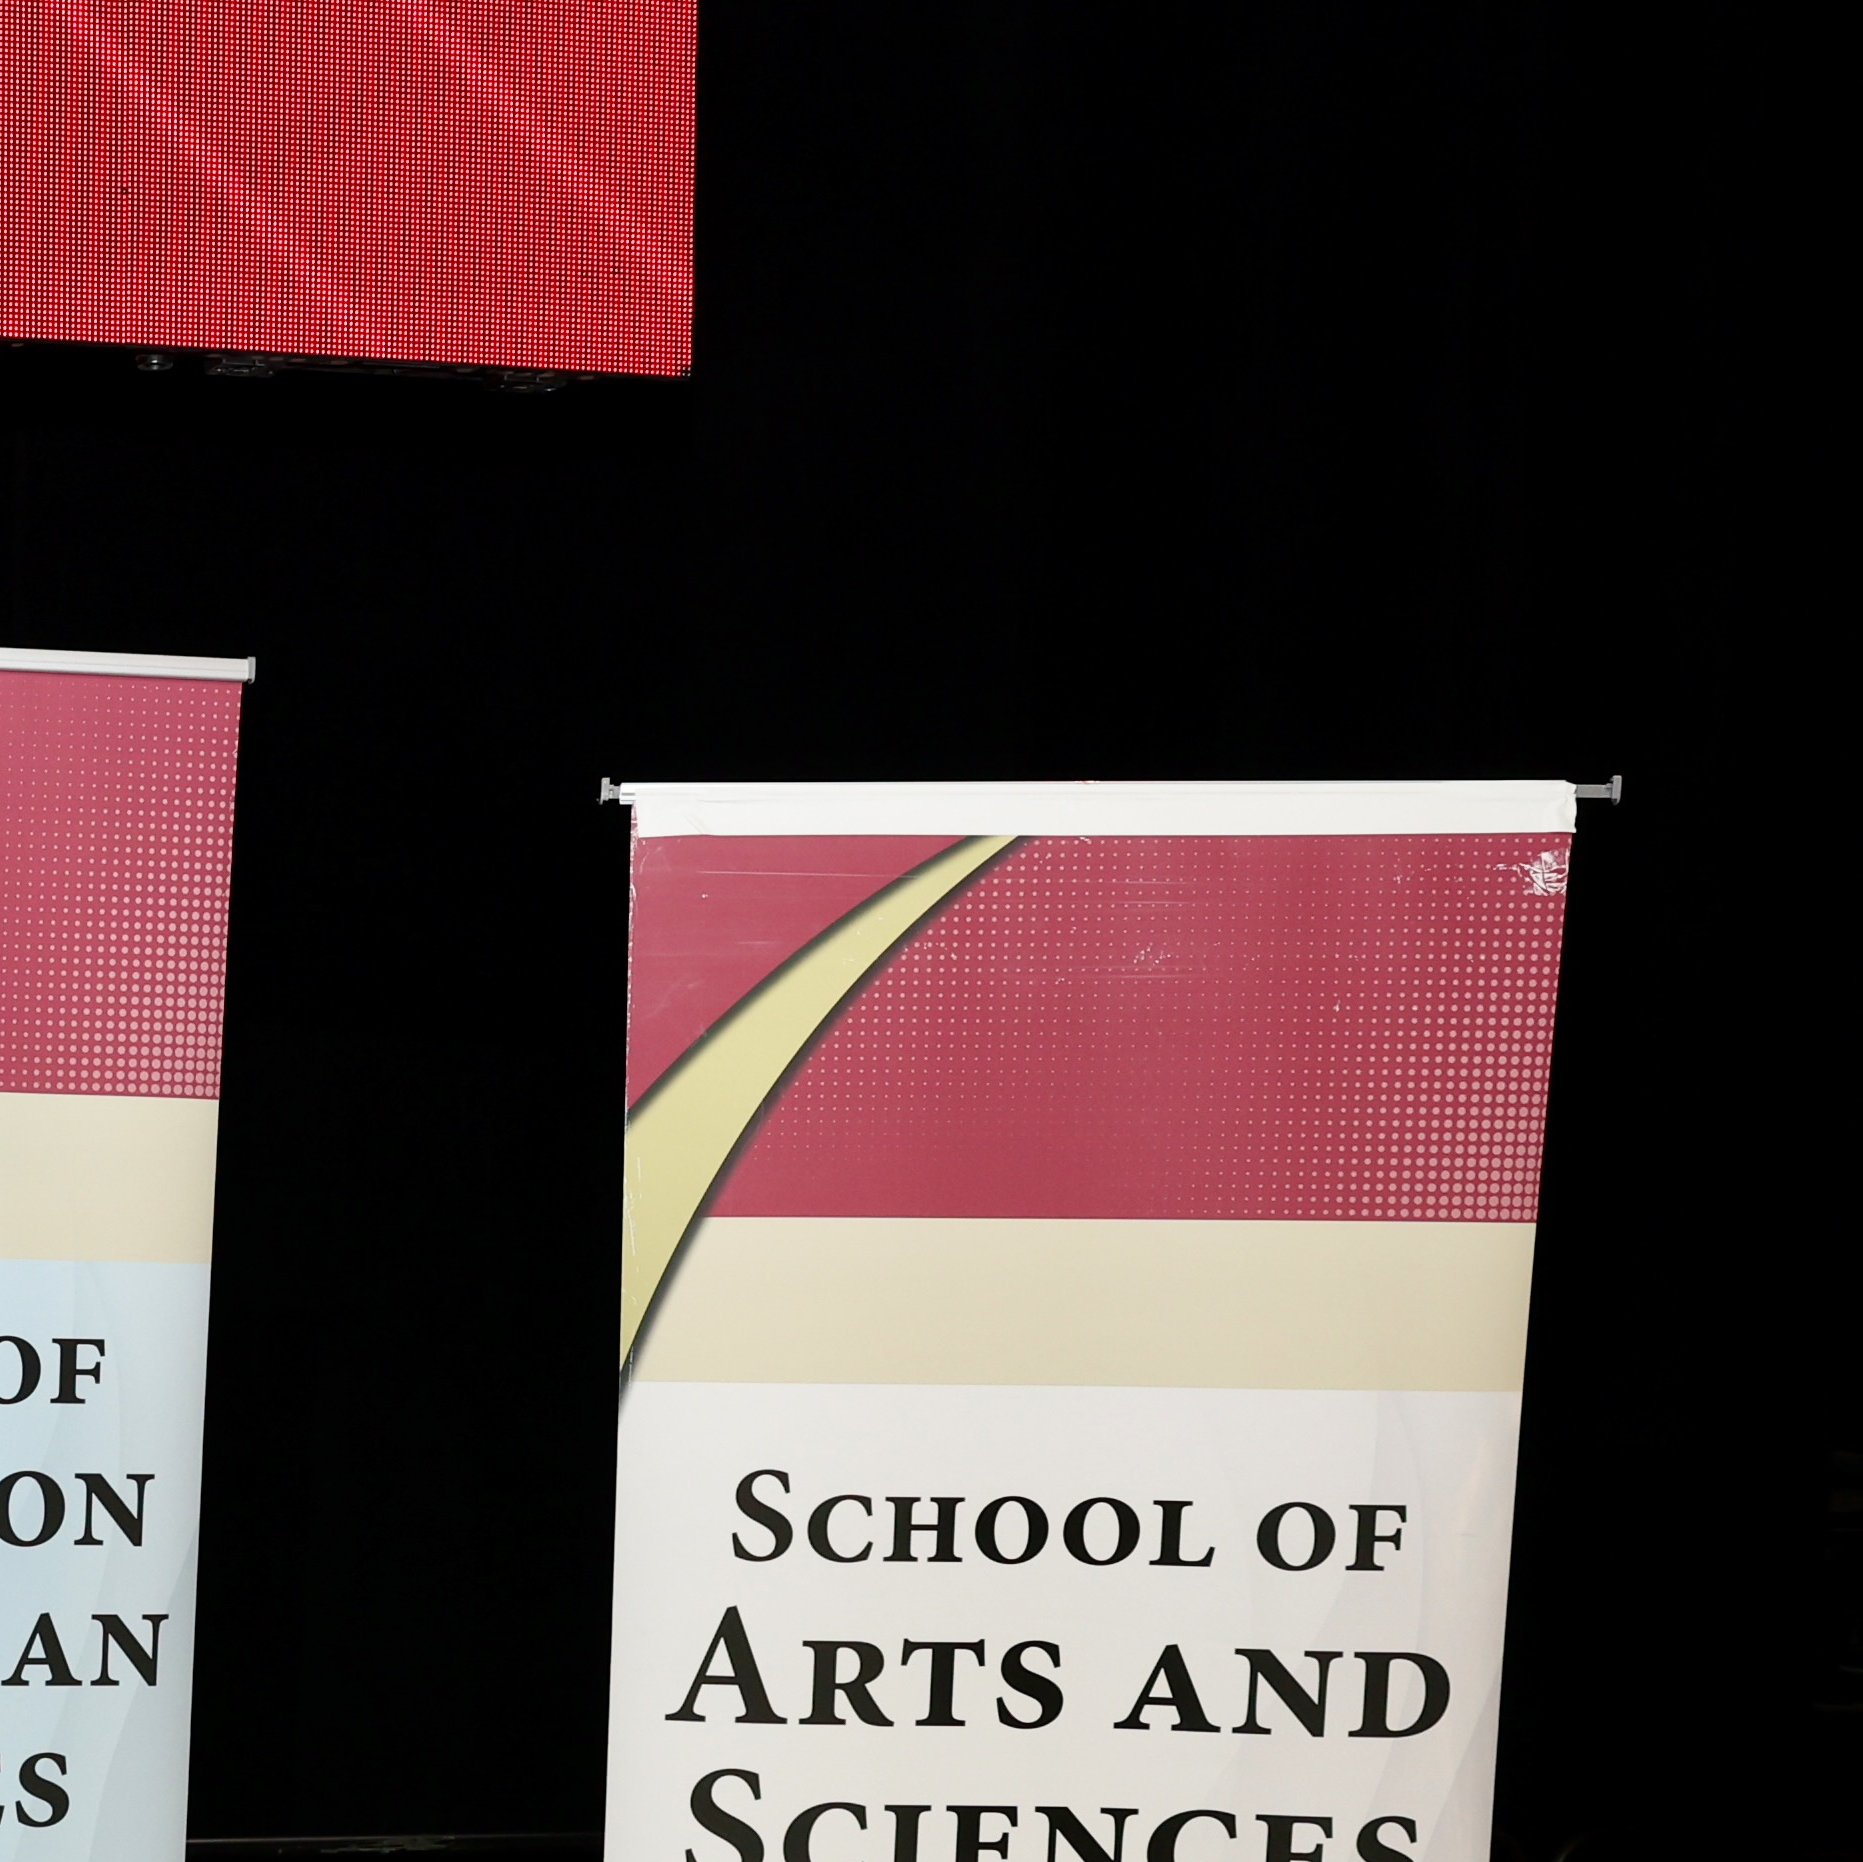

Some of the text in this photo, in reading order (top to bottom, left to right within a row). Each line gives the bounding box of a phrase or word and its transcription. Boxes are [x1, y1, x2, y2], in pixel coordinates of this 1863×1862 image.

[731, 1469, 1407, 1572] SCHOOL OF
[664, 1605, 1451, 1739] ARTS AND
